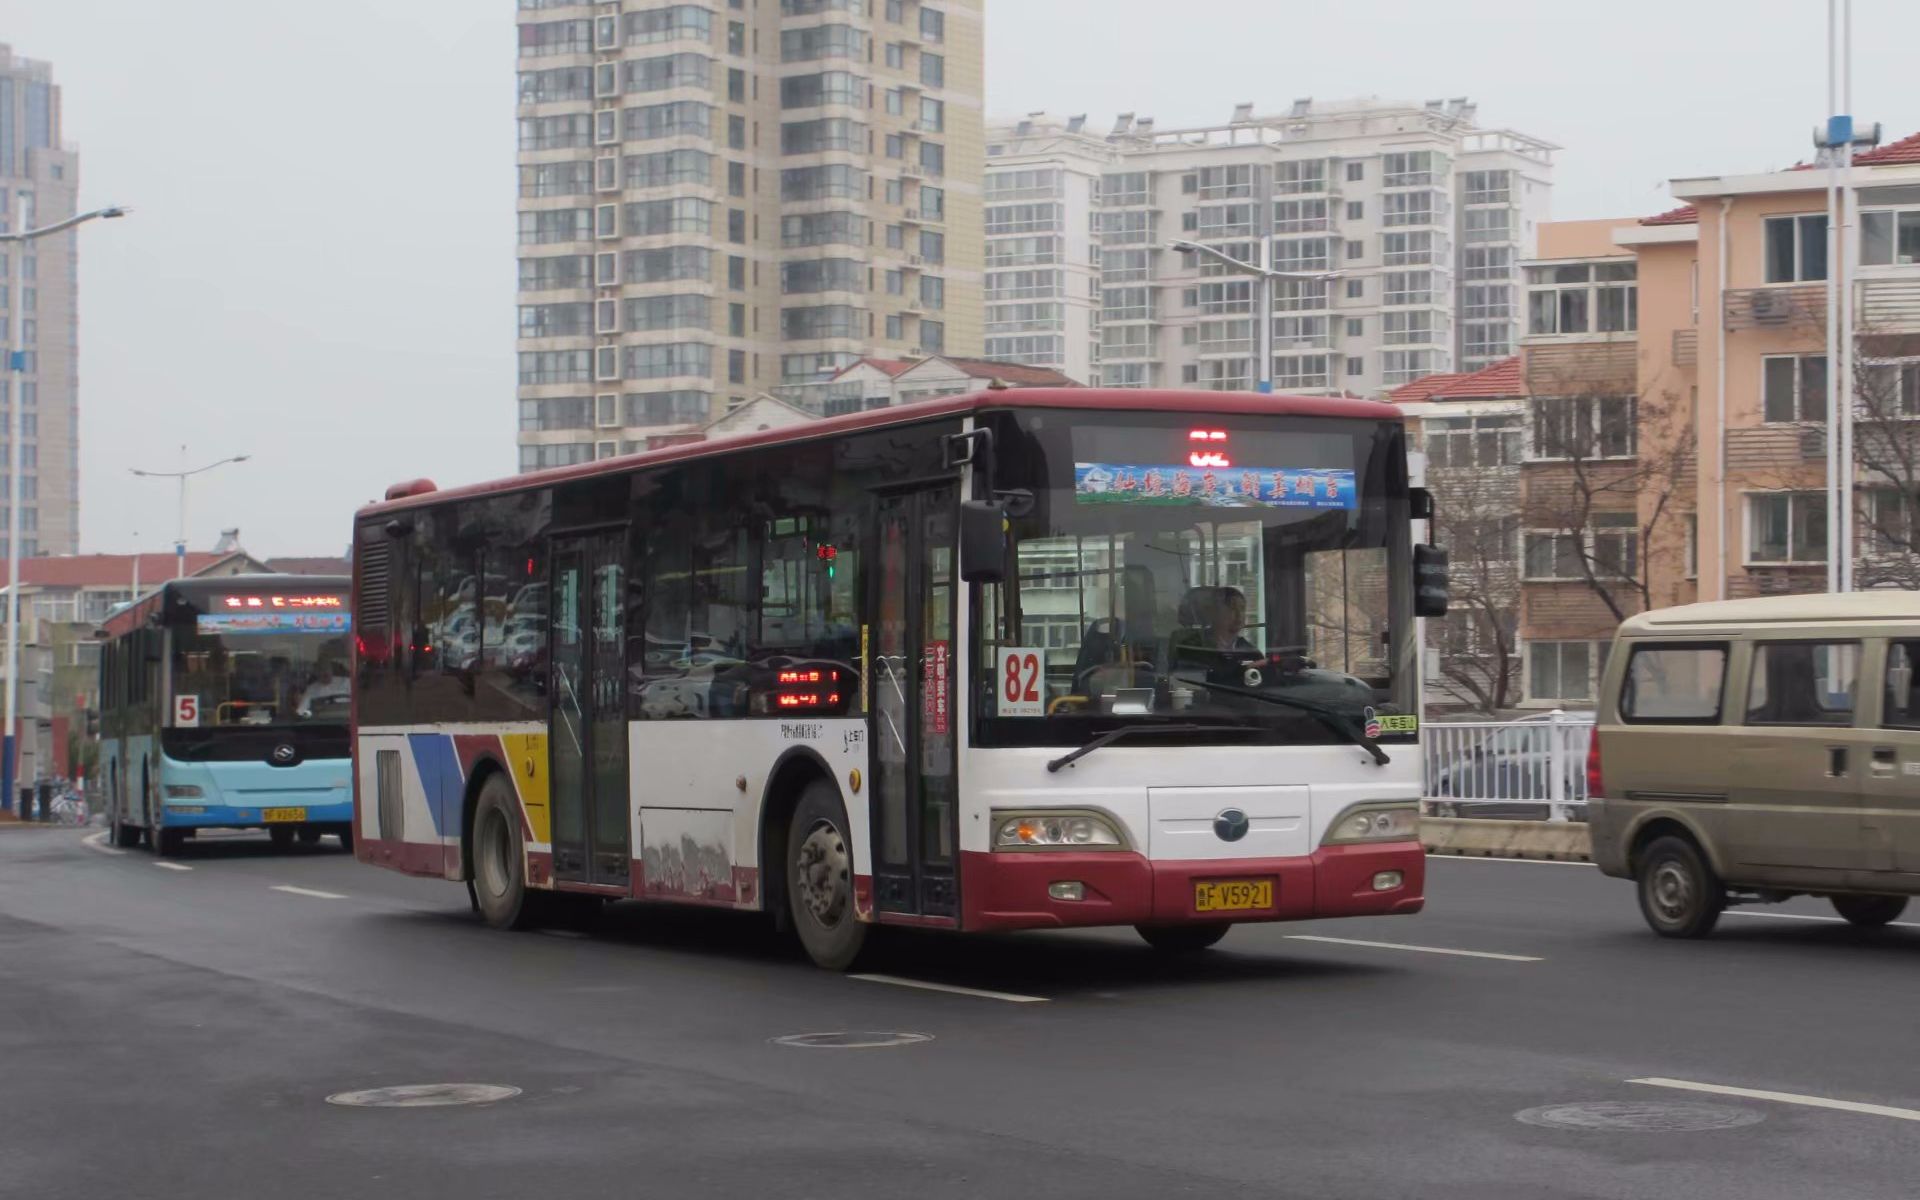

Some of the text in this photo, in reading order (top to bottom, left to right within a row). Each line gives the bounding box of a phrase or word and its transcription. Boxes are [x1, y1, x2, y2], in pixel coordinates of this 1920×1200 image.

[1005, 653, 1039, 702] 82
[180, 698, 196, 721] 5
[1221, 884, 1269, 907] V5921
